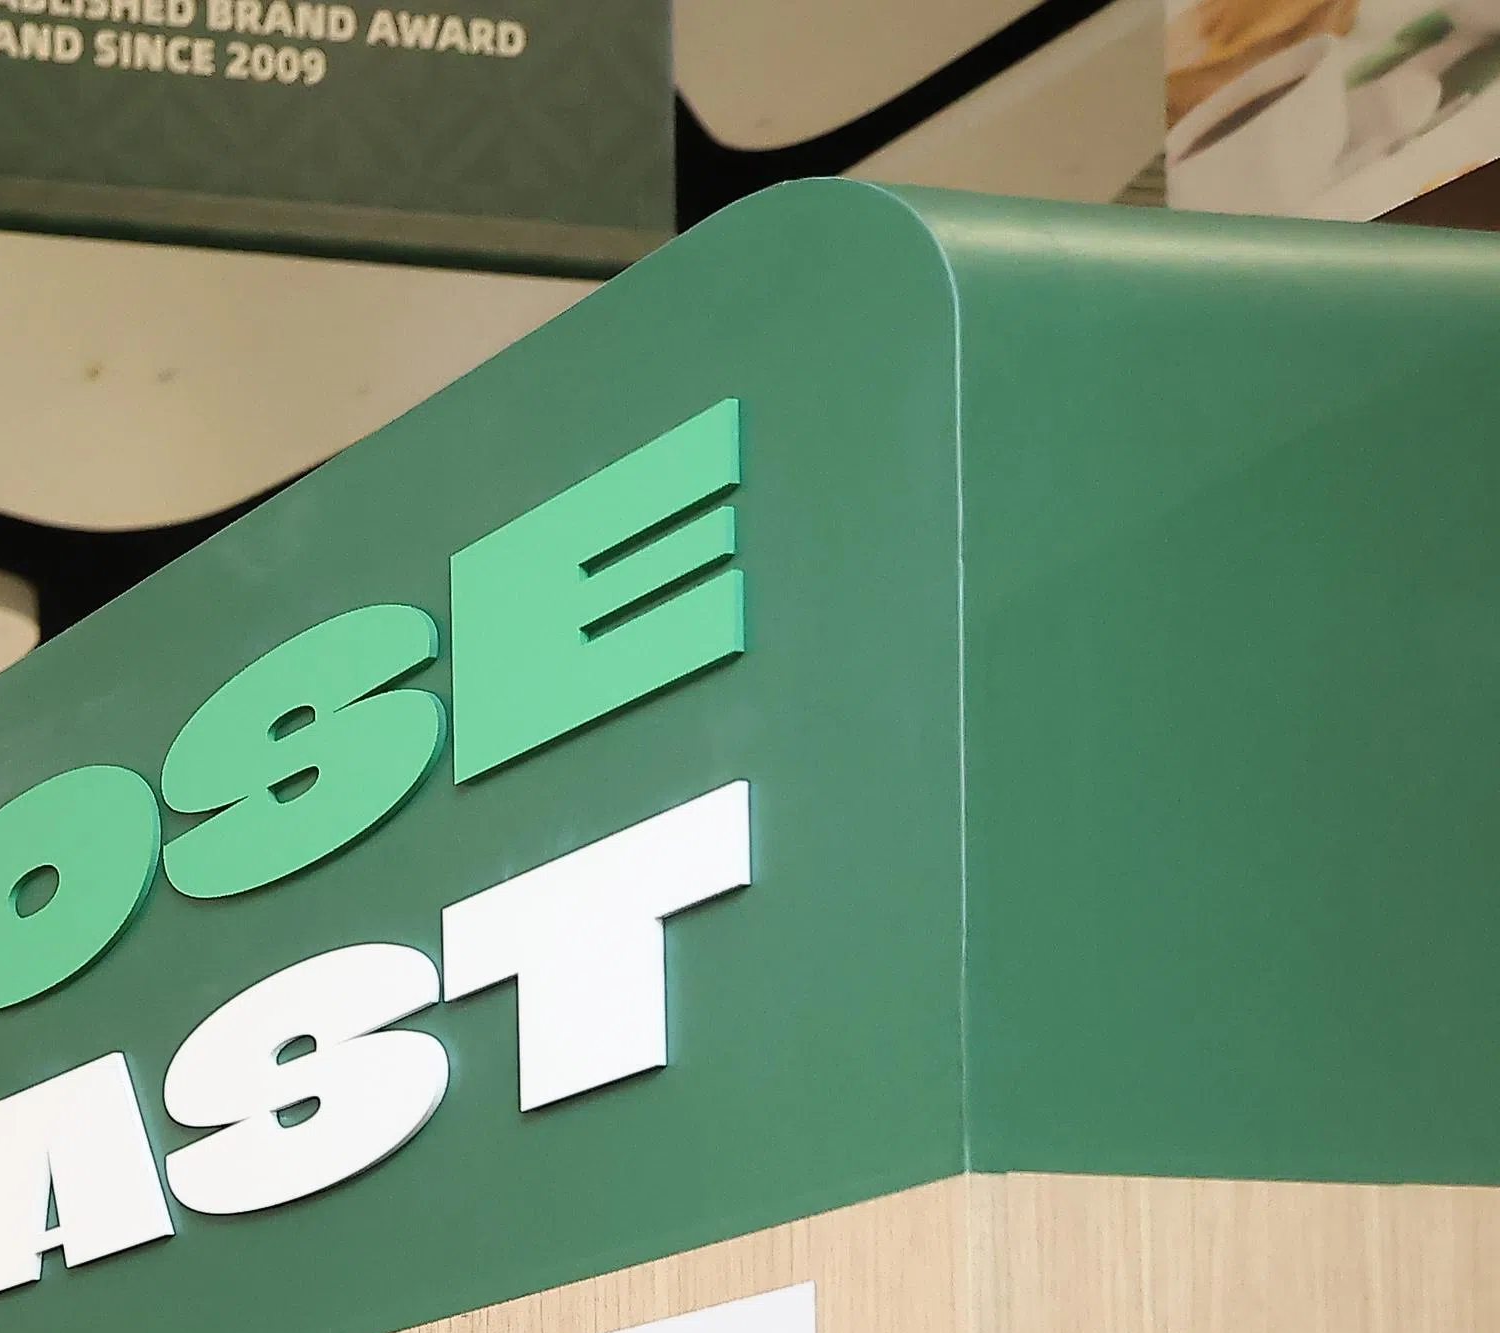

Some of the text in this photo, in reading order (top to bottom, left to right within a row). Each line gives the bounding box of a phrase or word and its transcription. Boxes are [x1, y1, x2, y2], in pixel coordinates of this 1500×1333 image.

[205, 0, 358, 42] BRAND
[366, 9, 528, 58] AWARD
[93, 30, 217, 77] SINCE
[225, 41, 327, 87] 2009
